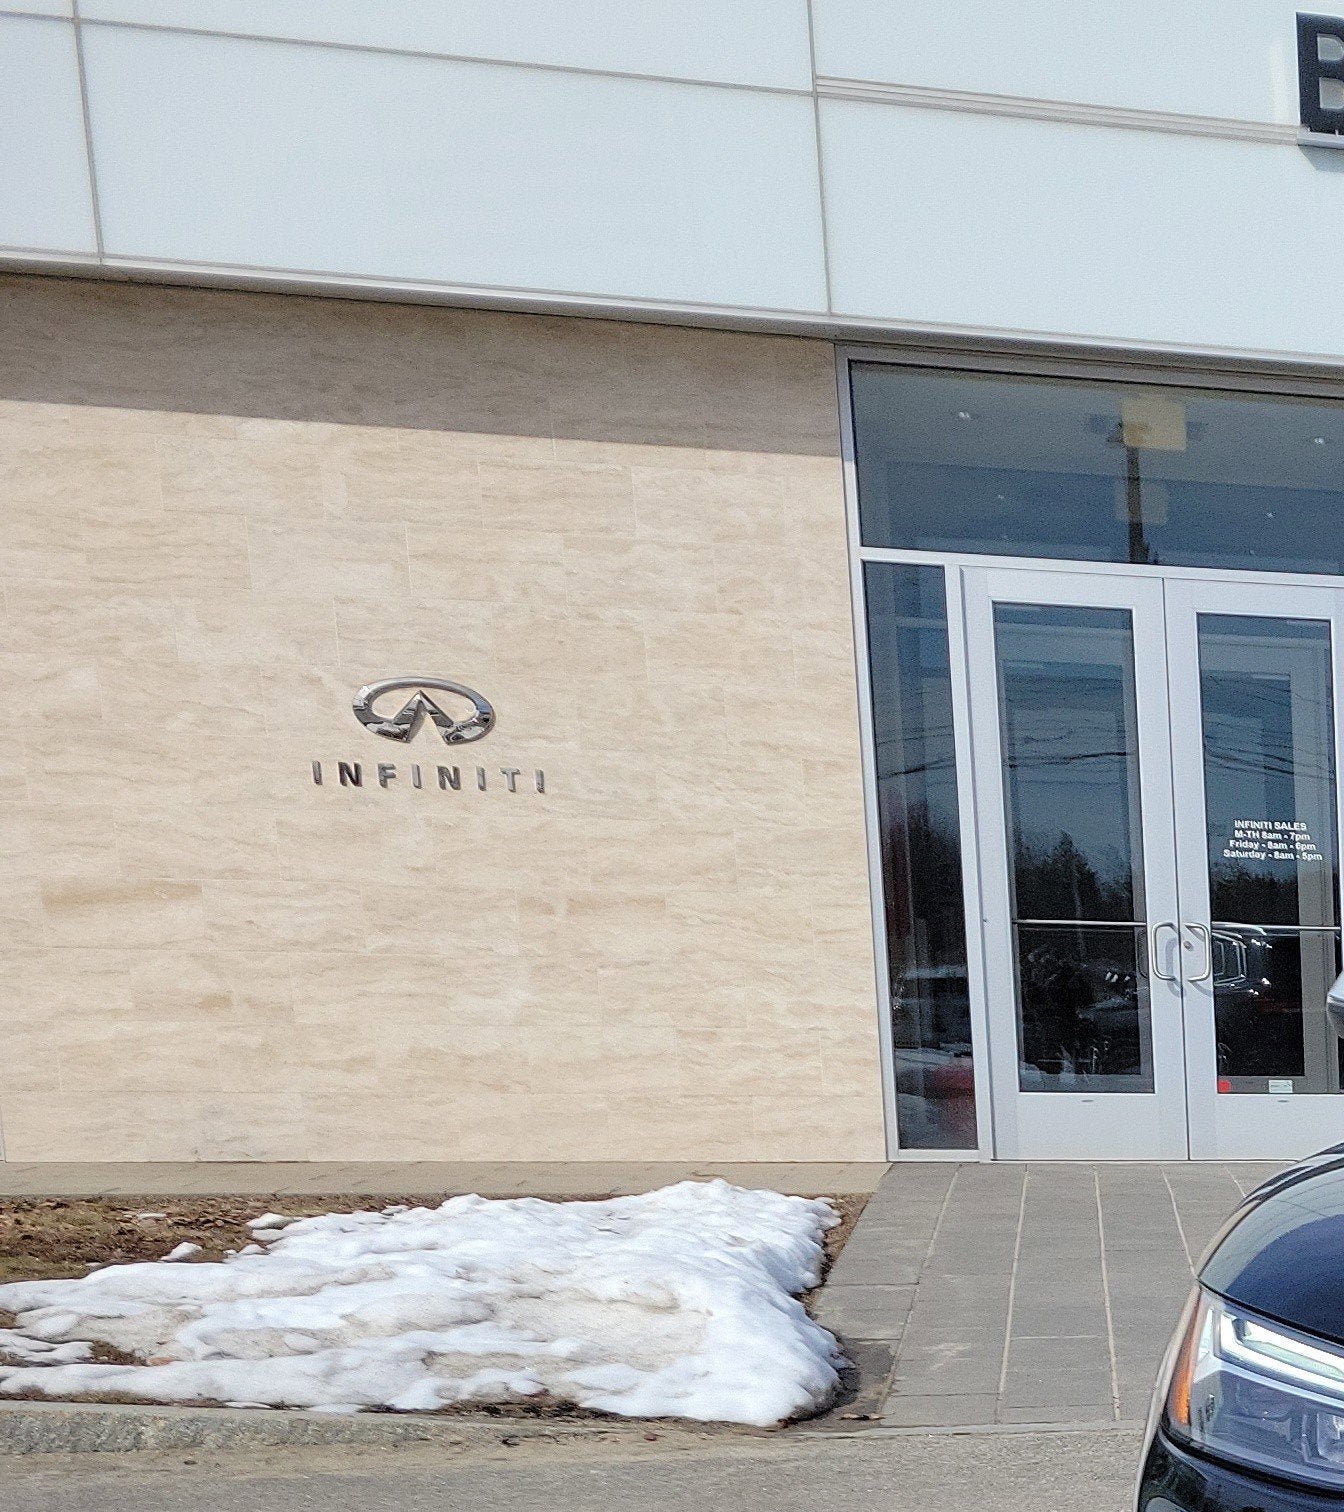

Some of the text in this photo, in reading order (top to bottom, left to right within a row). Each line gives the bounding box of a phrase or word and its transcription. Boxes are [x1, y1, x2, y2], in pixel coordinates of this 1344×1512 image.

[312, 760, 546, 793] INFINITI
[1234, 820, 1307, 831] INFINITI SALES
[1234, 830, 1259, 839] M-TH
[1261, 831, 1282, 840] 8am
[1290, 832, 1310, 842] 7pm
[1229, 840, 1260, 850] Friday
[1267, 841, 1288, 850] 8am
[1223, 849, 1266, 860] Saturday
[1273, 851, 1295, 860] 8am
[1301, 852, 1323, 861] 5pm
